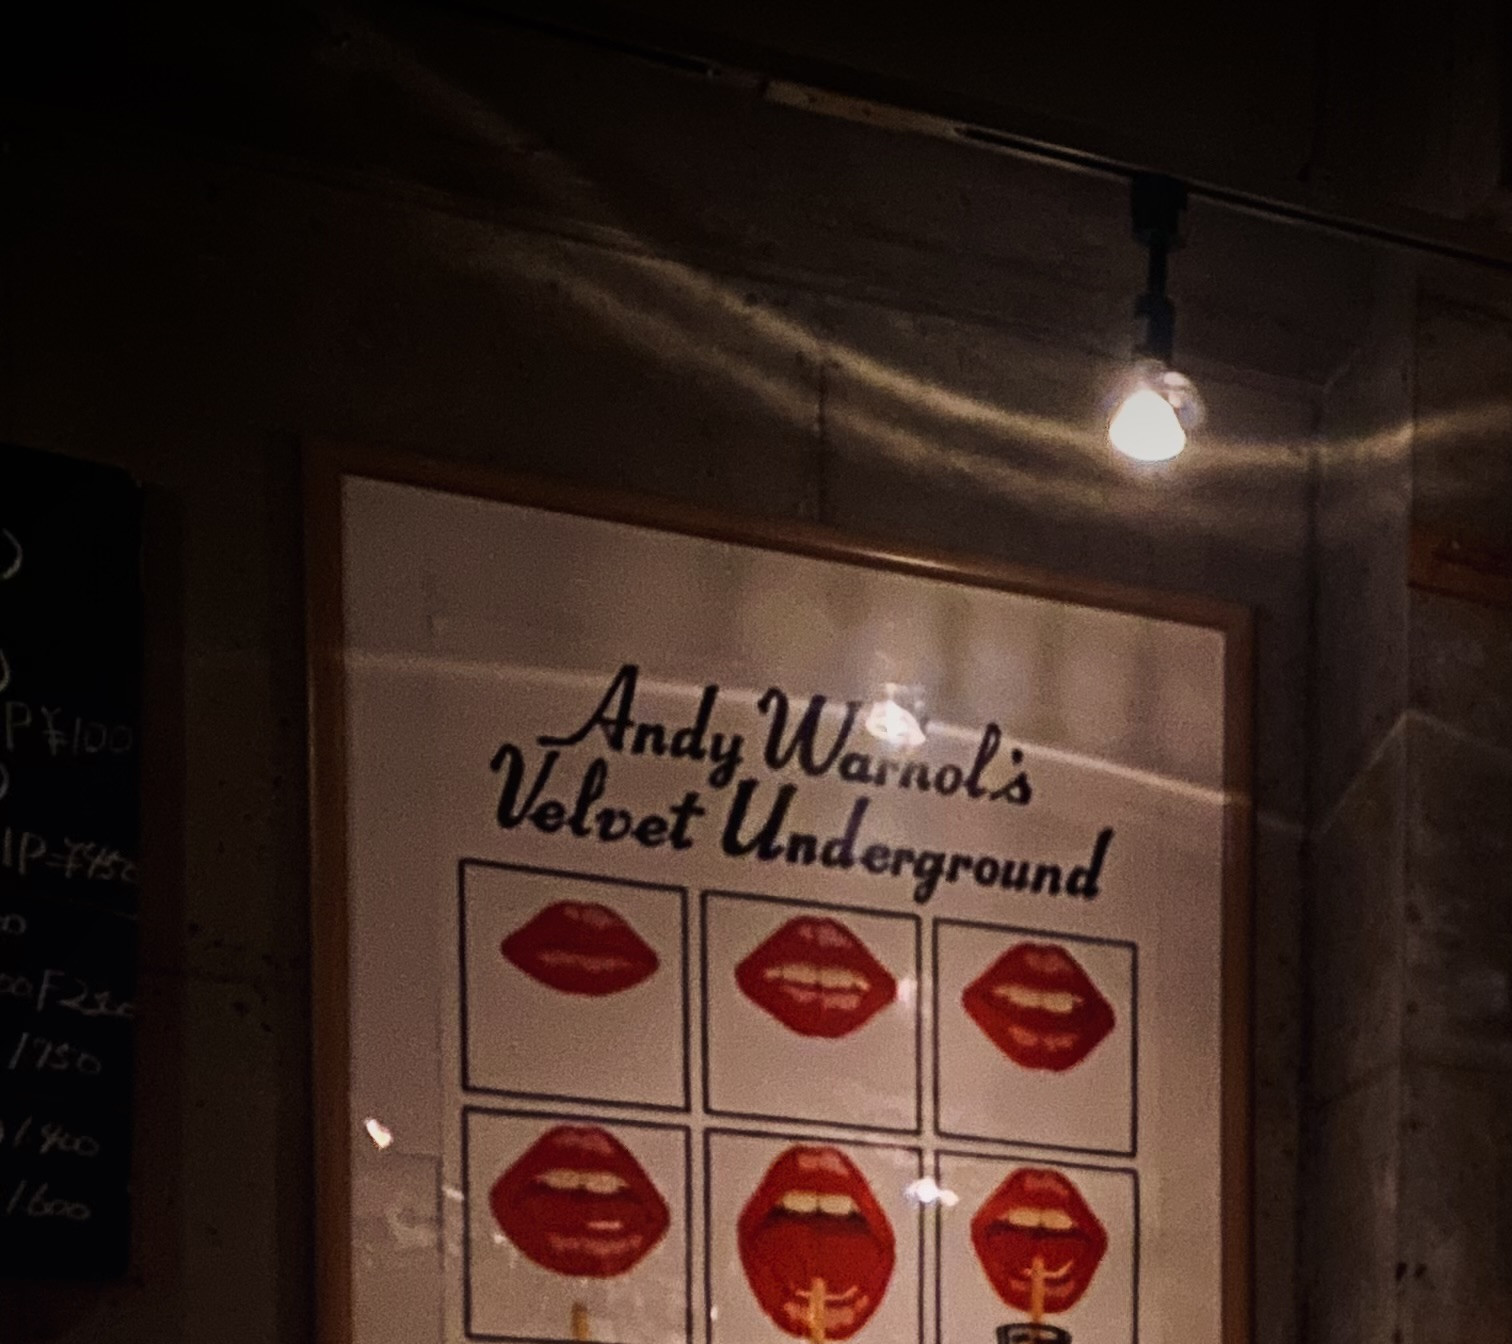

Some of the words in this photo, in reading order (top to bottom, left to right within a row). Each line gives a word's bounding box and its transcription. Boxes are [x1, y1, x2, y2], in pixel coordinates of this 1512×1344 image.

[537, 664, 743, 789] Andy
[490, 740, 706, 850] Velvet
[720, 778, 1115, 902] Underground
